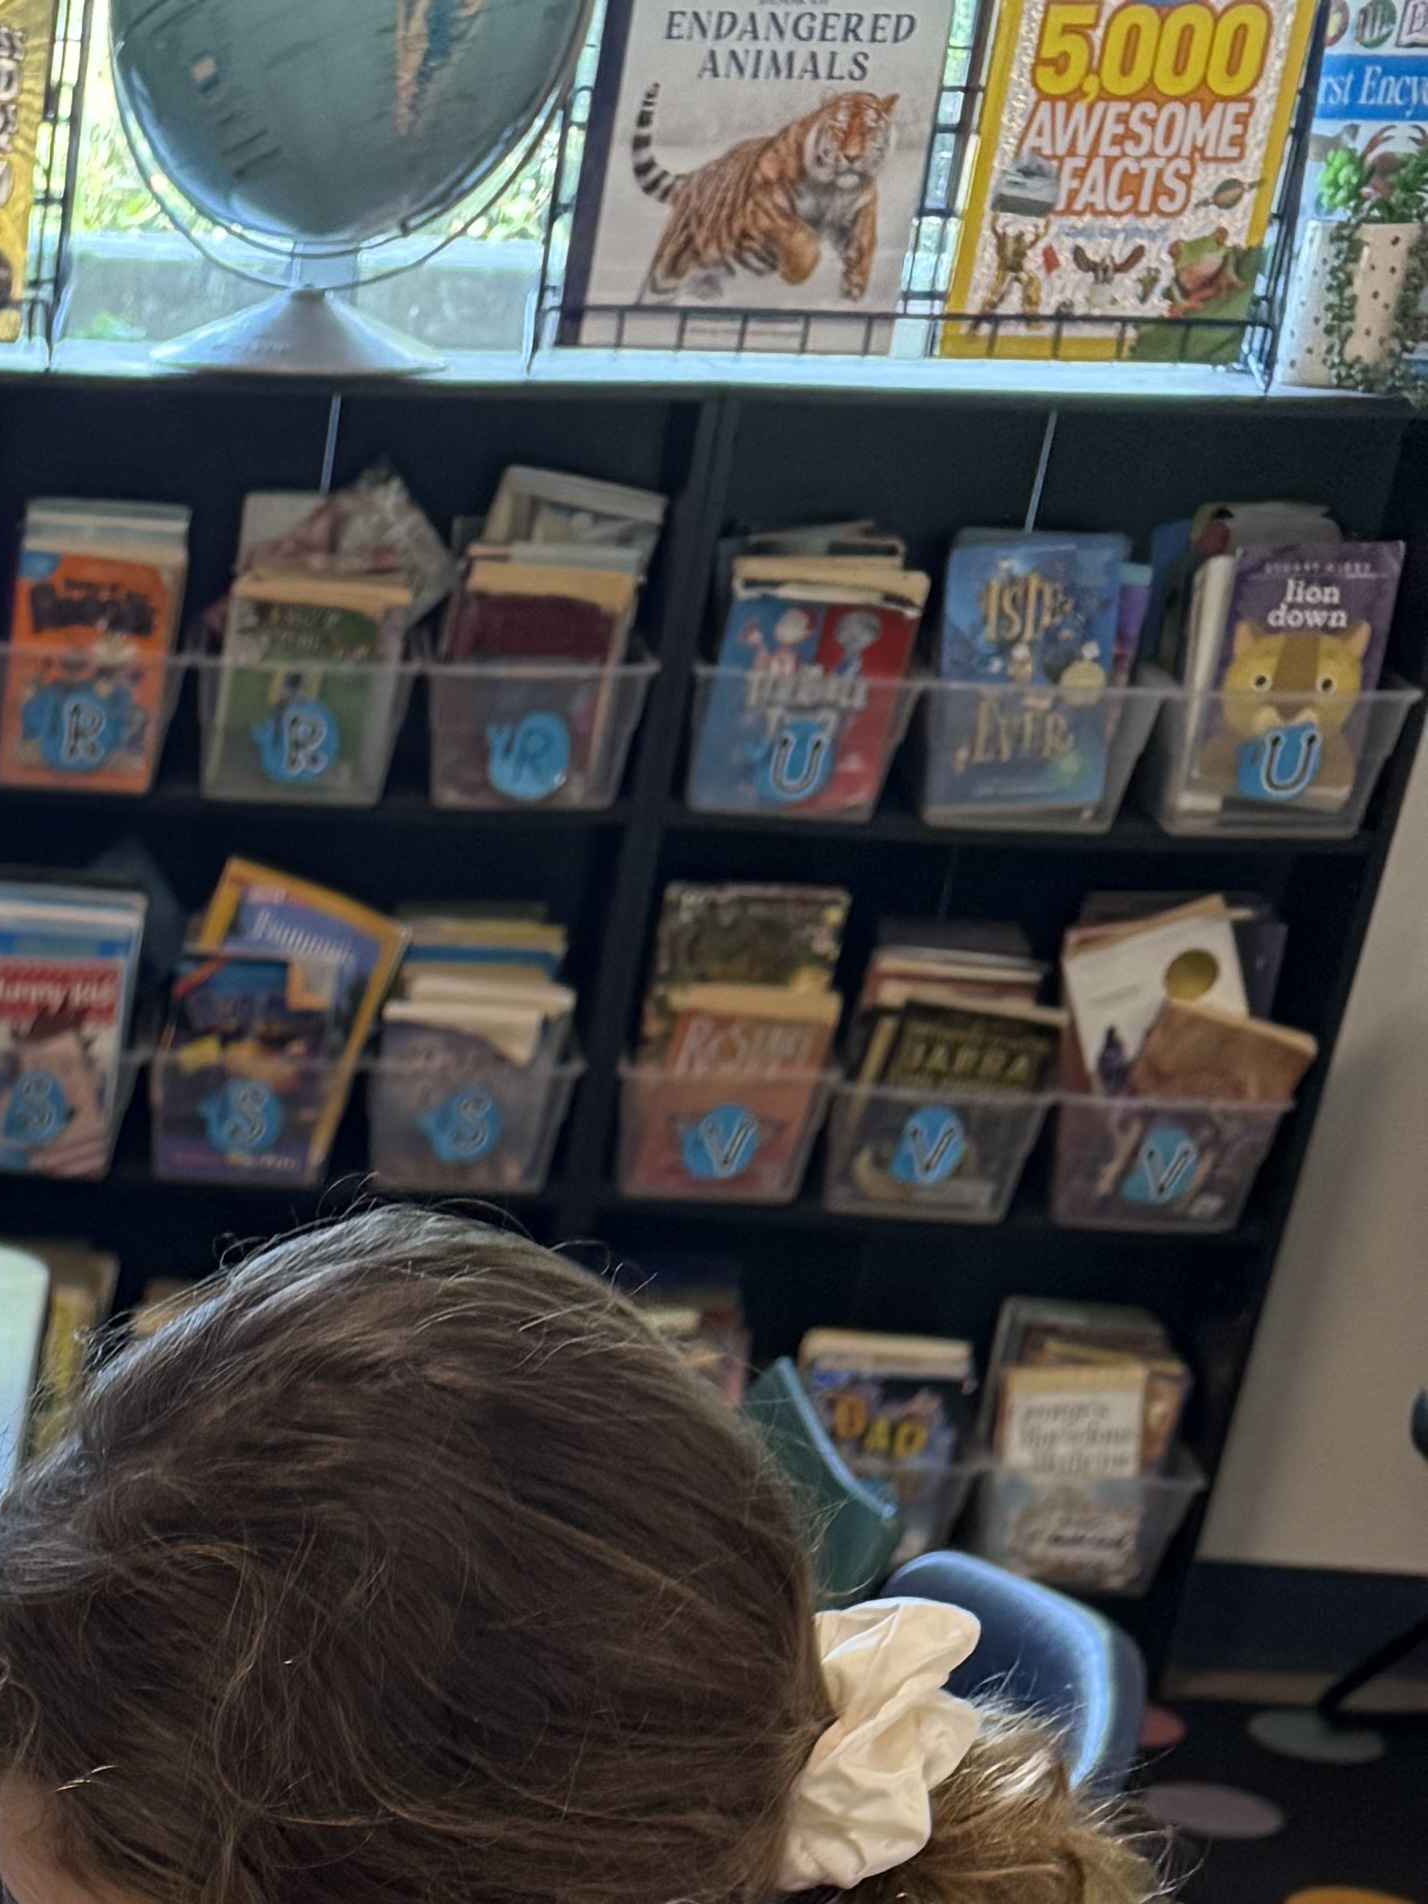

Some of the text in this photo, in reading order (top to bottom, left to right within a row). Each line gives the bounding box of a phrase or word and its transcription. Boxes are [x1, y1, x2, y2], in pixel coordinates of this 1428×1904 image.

[663, 8, 918, 47] ENDANGERED
[1031, 2, 1272, 106] 5,000
[695, 49, 870, 83] ANIMALS
[1021, 100, 1251, 161] AWESOME
[1056, 154, 1195, 218] FACTS
[1266, 602, 1348, 631] down
[1283, 577, 1341, 607] lion
[60, 701, 106, 764] R
[285, 712, 329, 775] R
[772, 732, 832, 795] U
[1261, 730, 1320, 796] U
